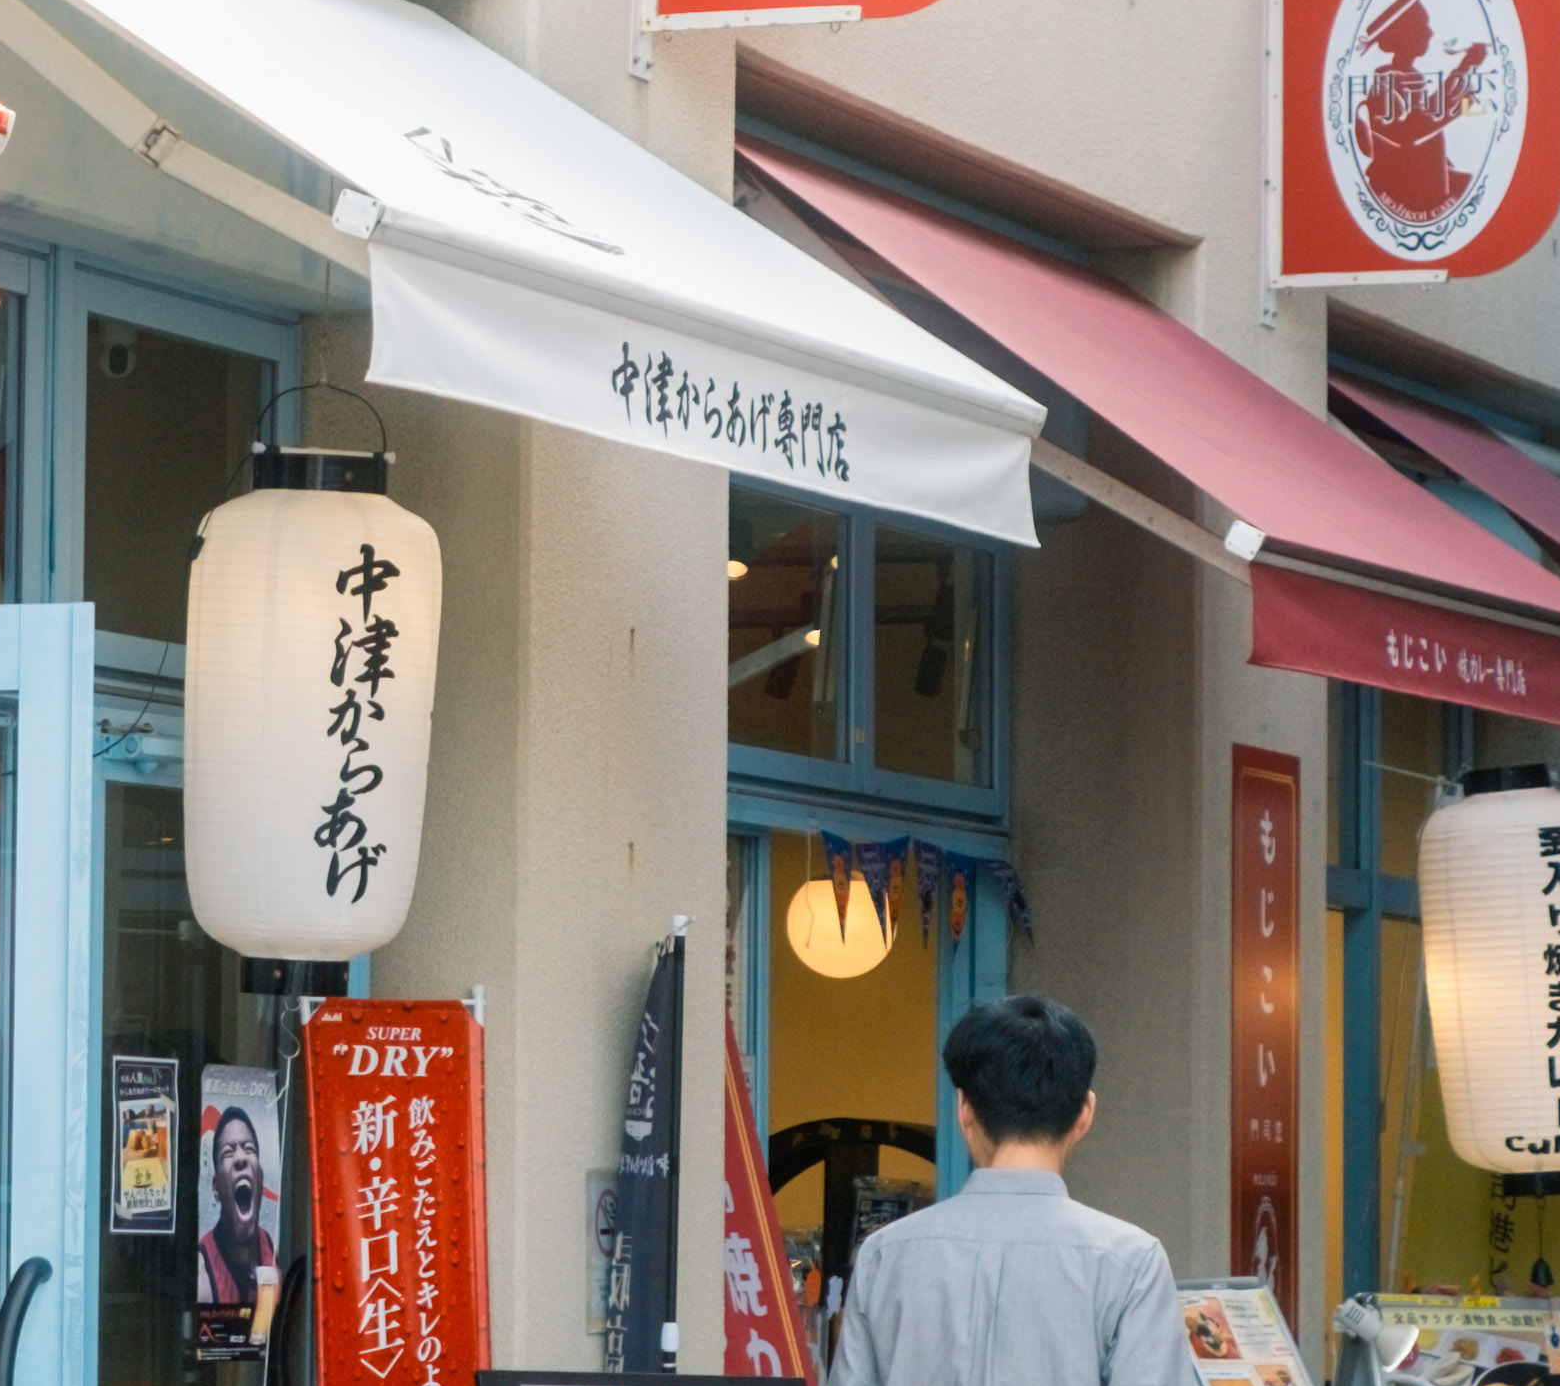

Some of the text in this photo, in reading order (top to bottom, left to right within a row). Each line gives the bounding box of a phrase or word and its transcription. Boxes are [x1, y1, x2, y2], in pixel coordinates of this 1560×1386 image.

[611, 341, 850, 481] 中津からあげ専門店
[1386, 628, 1447, 674] もじこい
[313, 543, 401, 905] 中津からあげ
[1256, 809, 1277, 1088] もじこい
[366, 1025, 422, 1042] SUPER
